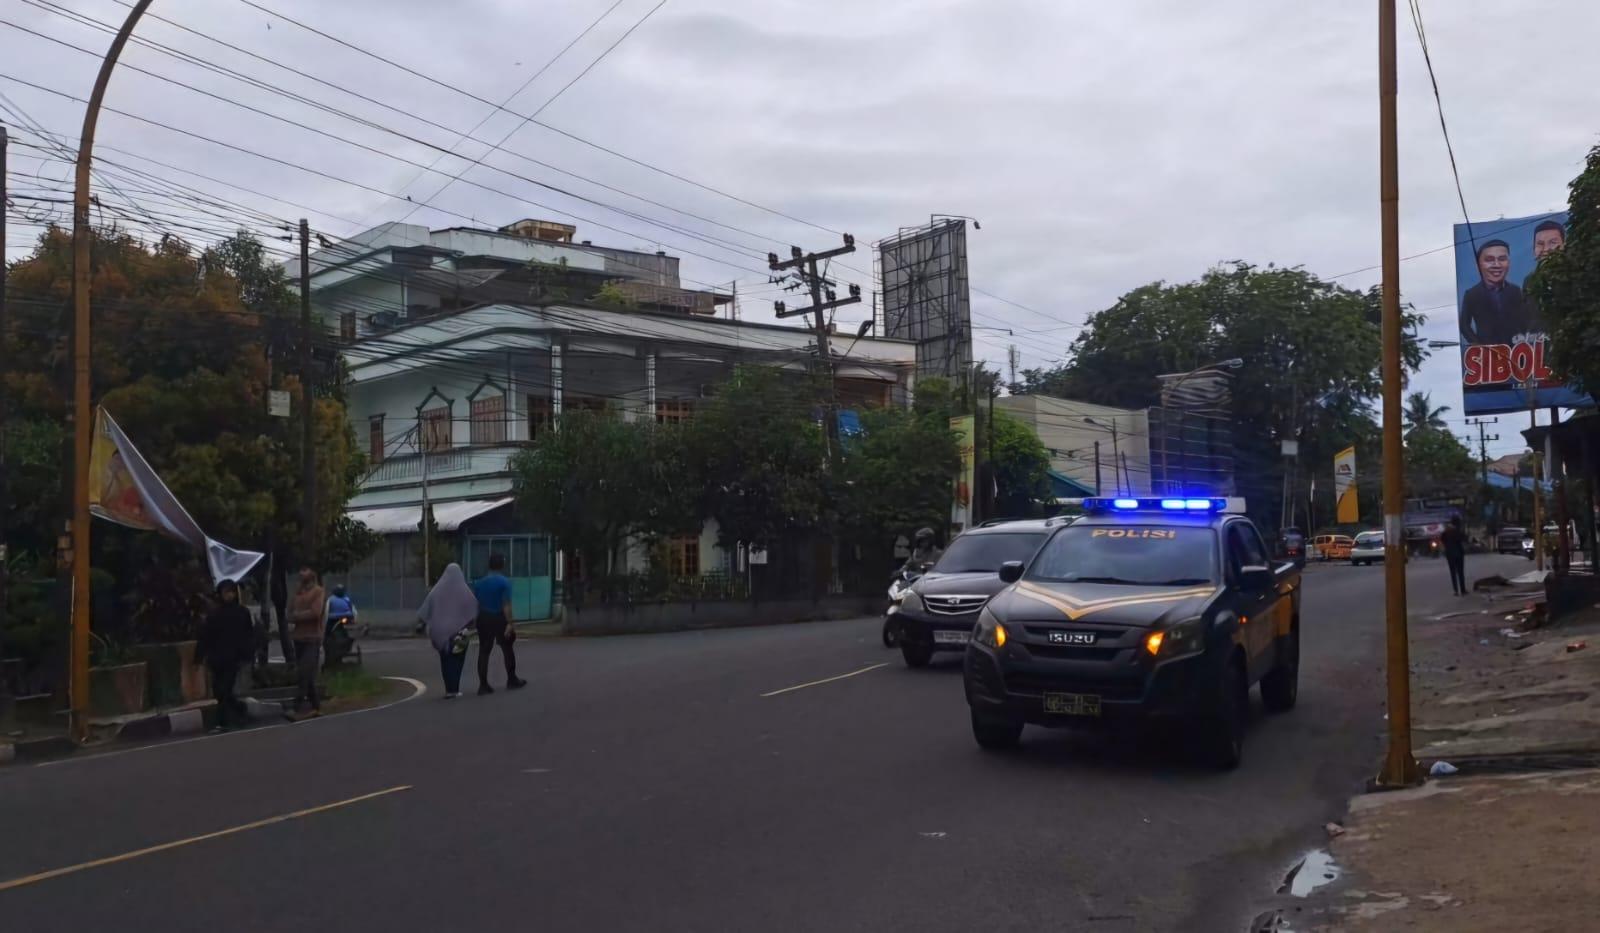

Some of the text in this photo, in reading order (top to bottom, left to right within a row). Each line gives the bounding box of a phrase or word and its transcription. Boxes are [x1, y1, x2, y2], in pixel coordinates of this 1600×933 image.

[1463, 340, 1553, 385] SIBOL
[1091, 528, 1176, 539] POLISI
[1049, 632, 1095, 644] ISUZU
